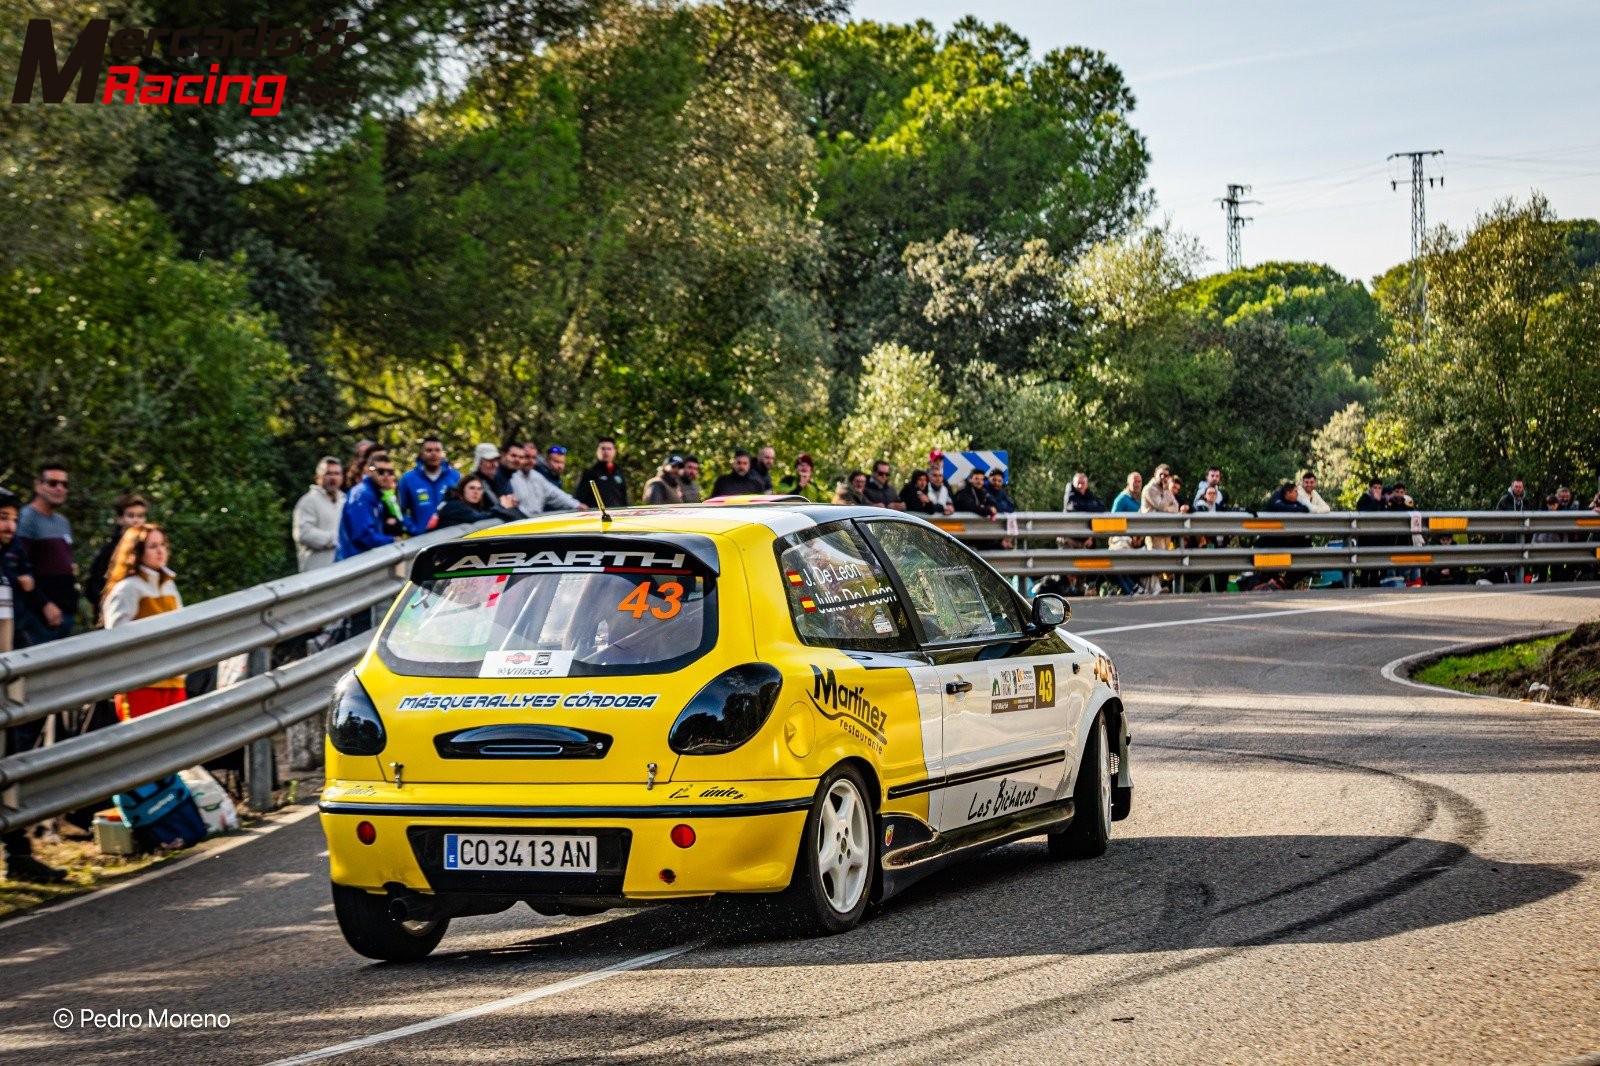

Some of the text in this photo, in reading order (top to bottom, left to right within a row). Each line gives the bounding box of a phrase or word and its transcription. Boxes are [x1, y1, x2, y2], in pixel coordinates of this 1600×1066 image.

[446, 550, 685, 571] ABARTH
[813, 565, 833, 585] De
[829, 560, 862, 581] León
[617, 581, 684, 620] 43
[398, 690, 658, 712] MÁSQUERALLYES CÓRDOBA
[809, 663, 888, 735] Martínez
[1038, 669, 1053, 703] 43
[839, 719, 884, 755] restaurante
[460, 839, 592, 868] CO 3413 AN
